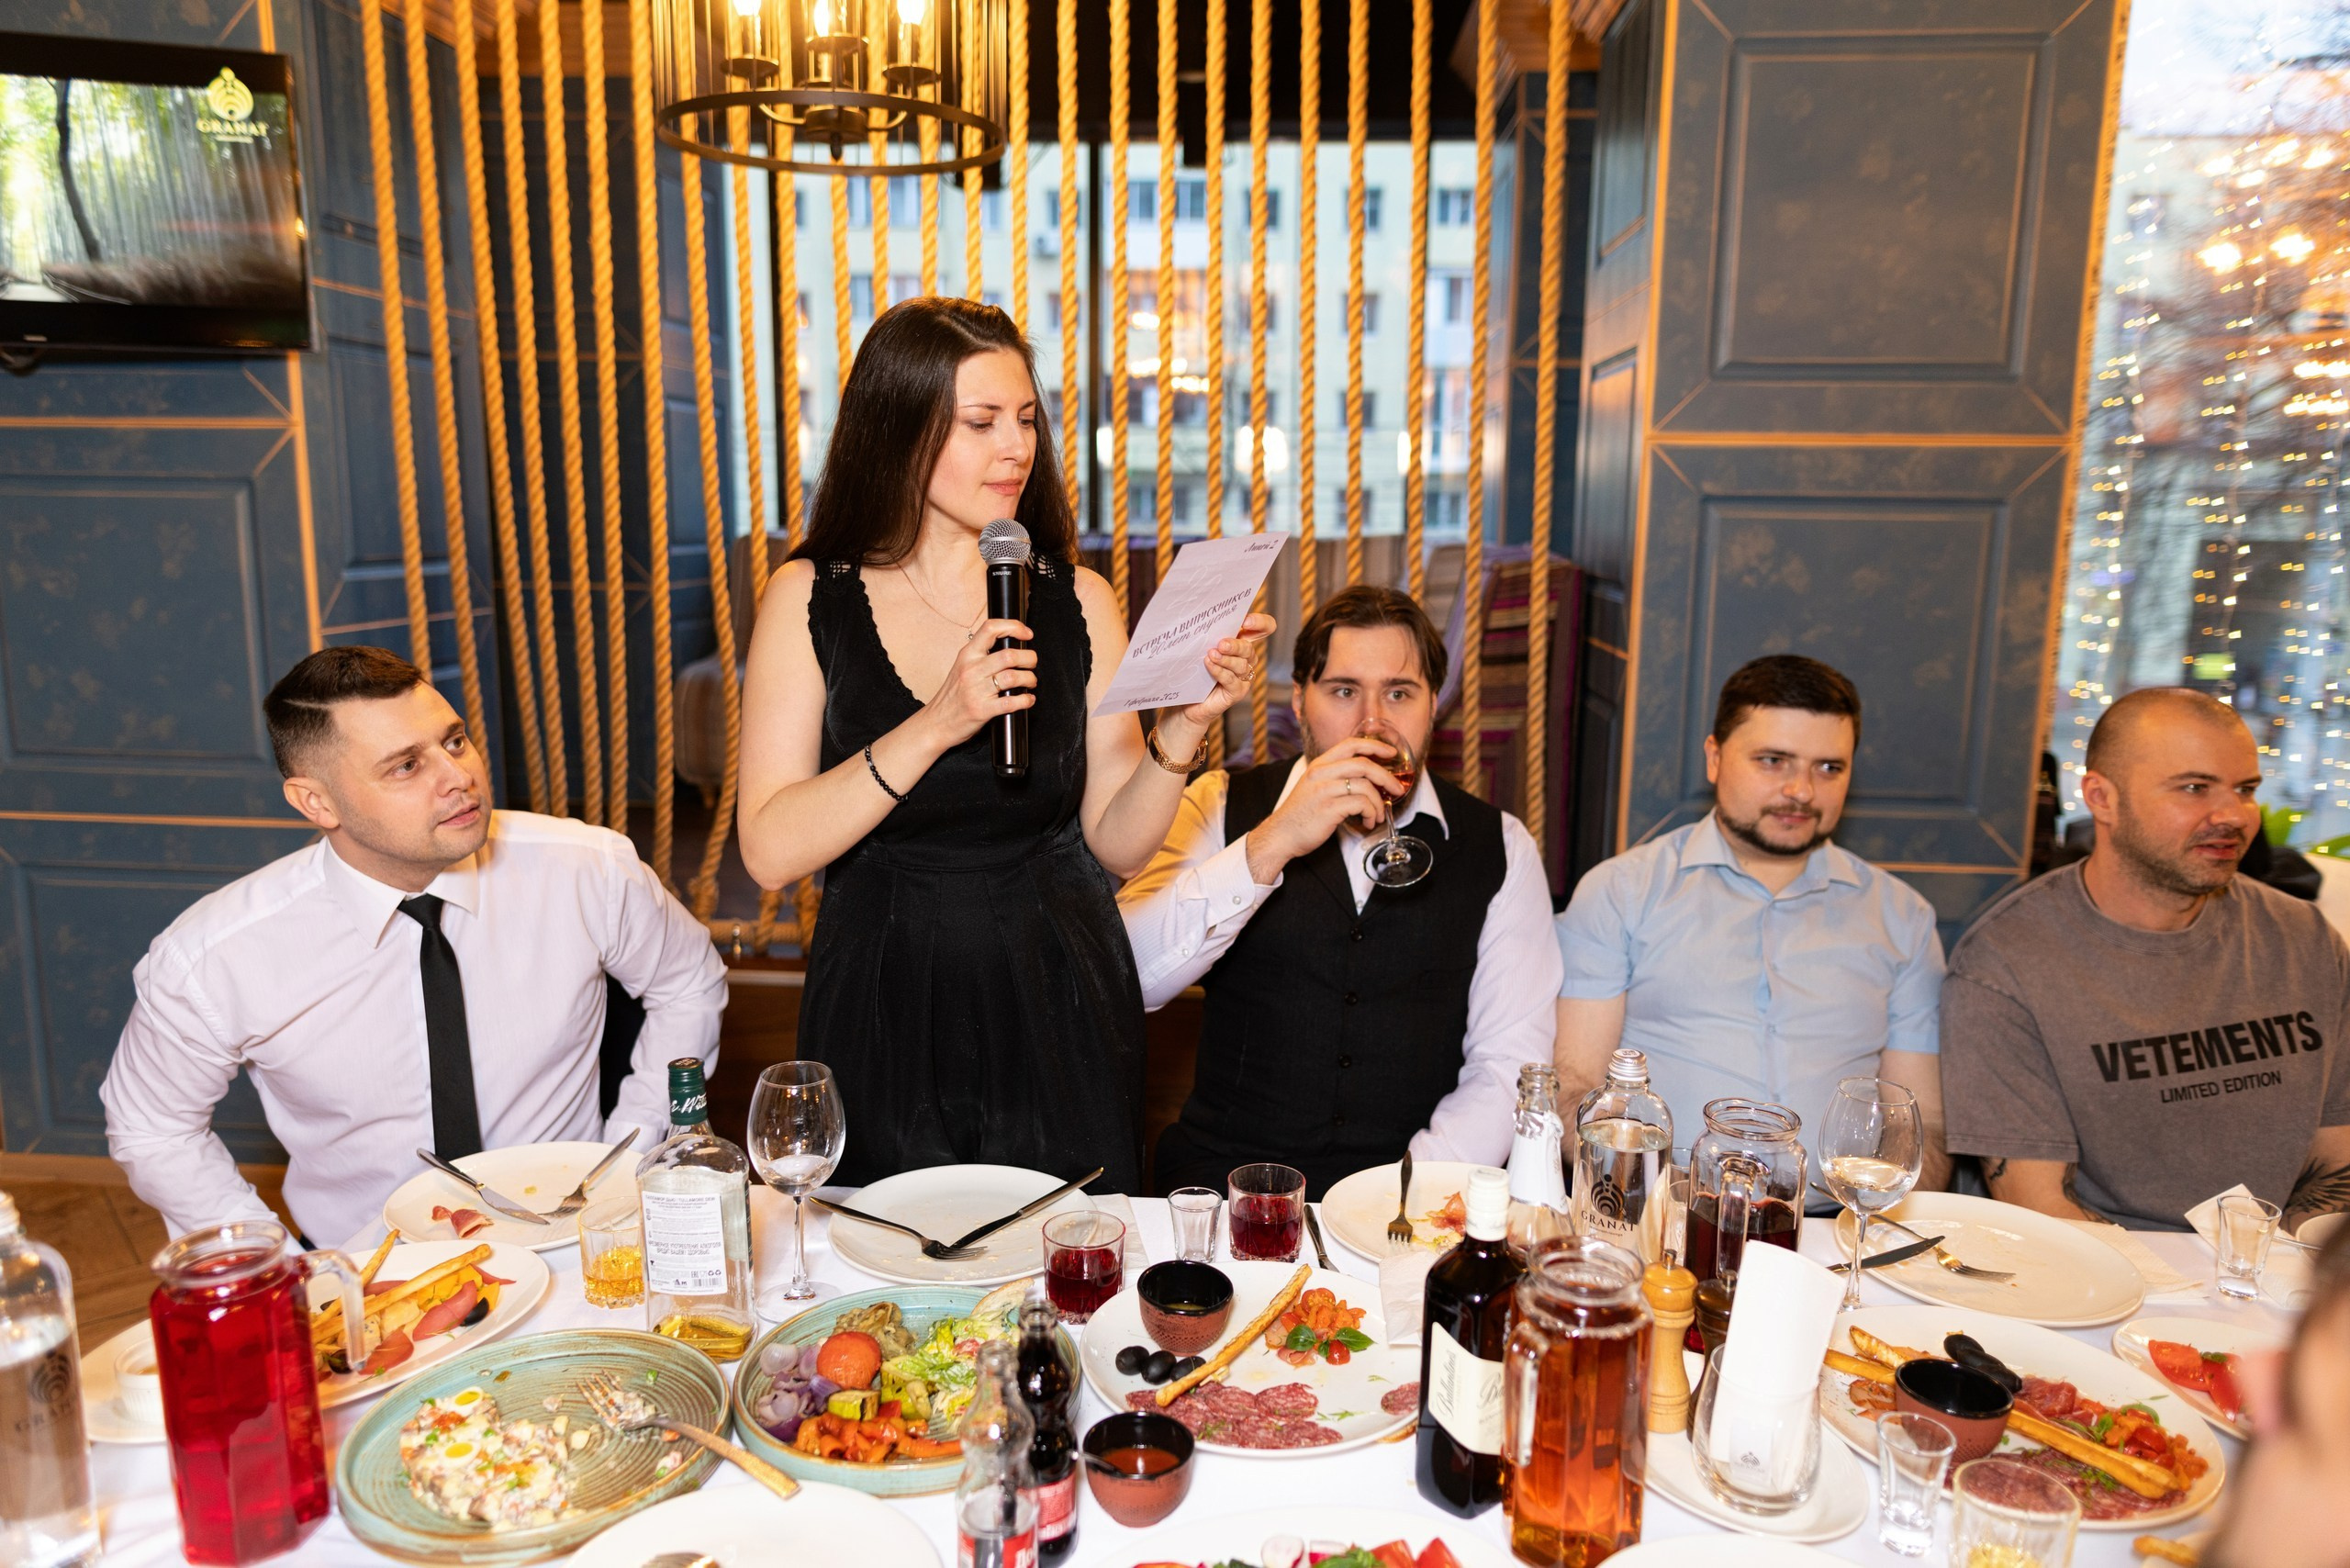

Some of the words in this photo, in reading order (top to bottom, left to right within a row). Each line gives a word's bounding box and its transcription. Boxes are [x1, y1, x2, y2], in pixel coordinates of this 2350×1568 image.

[1132, 627, 1178, 658] ВСТРЕЧА
[1179, 588, 1252, 633] ВЫПУСКНИКОВ
[1147, 641, 1164, 659] 20
[2090, 1011, 2323, 1082] VETEMENTS
[2160, 1081, 2221, 1103] LIMITED
[2222, 1070, 2282, 1093] EDITION
